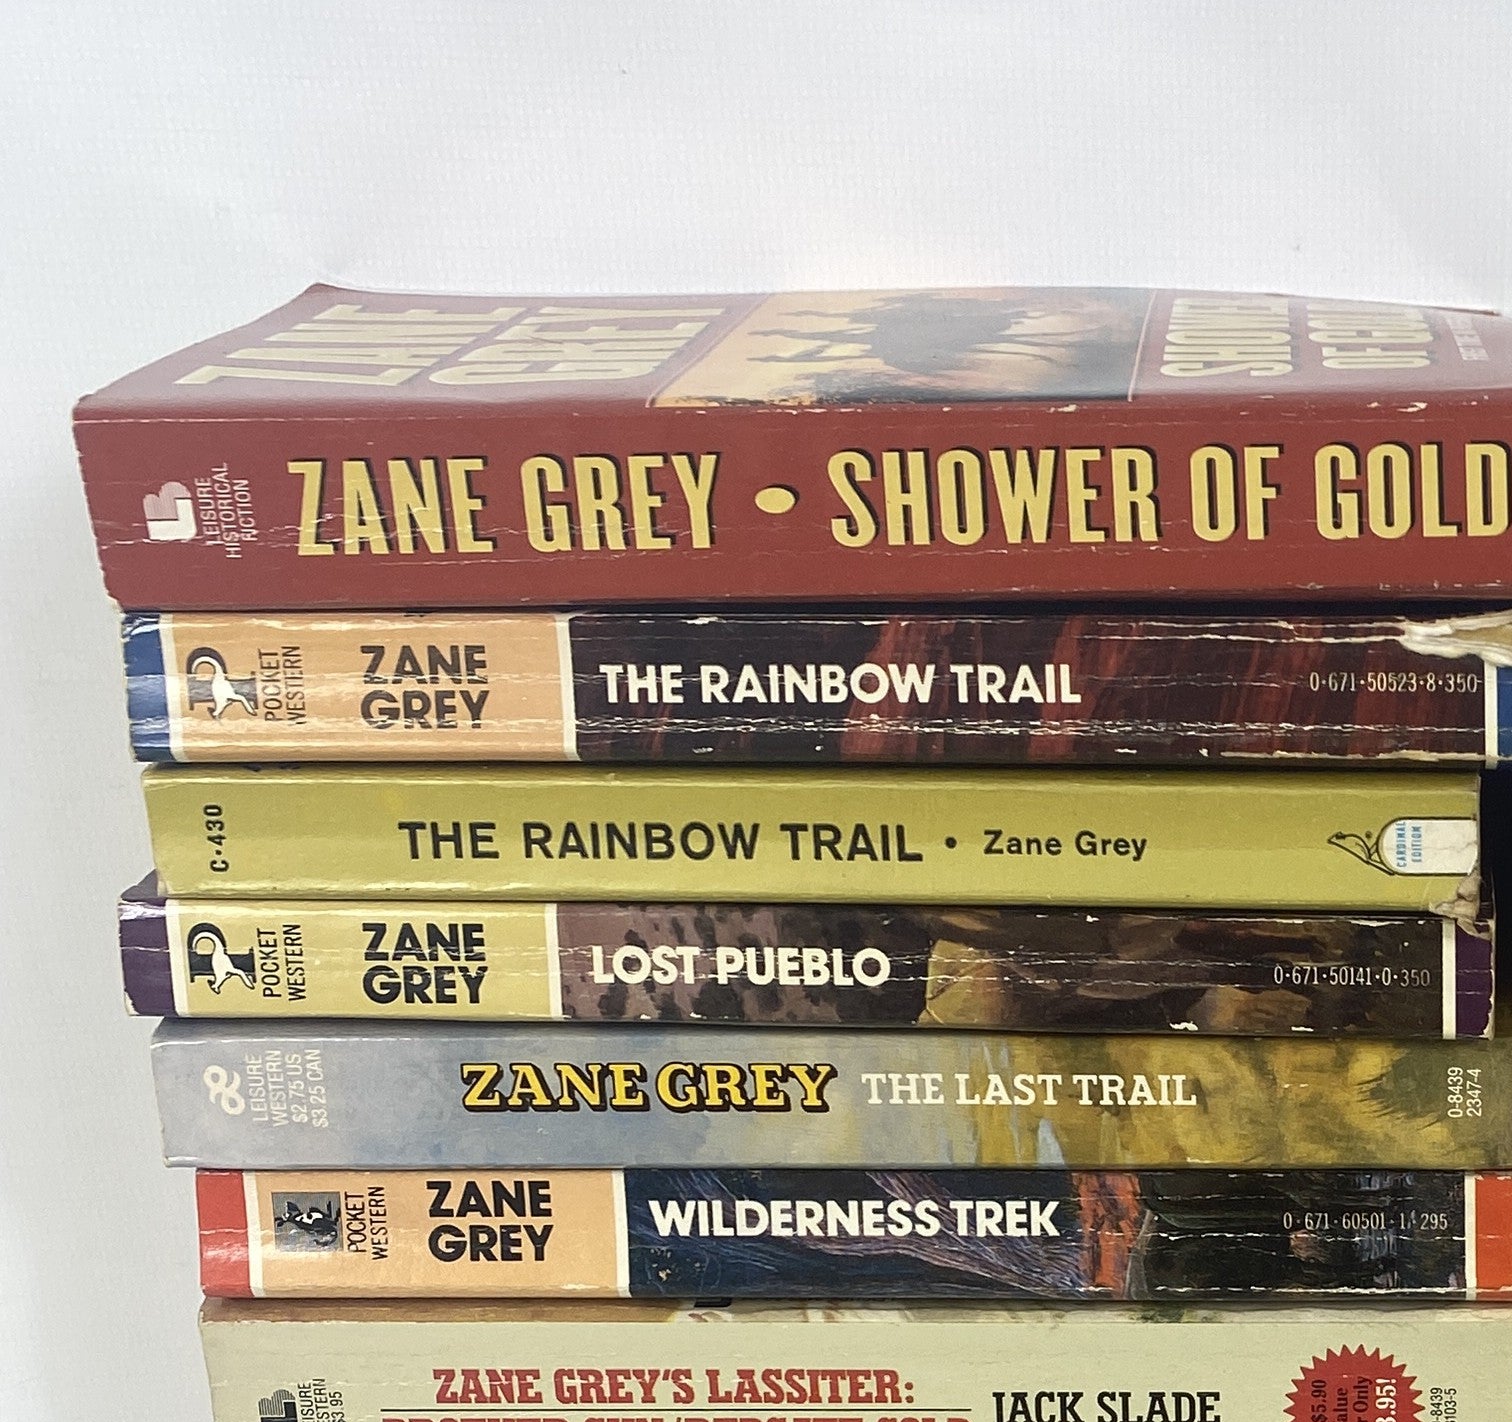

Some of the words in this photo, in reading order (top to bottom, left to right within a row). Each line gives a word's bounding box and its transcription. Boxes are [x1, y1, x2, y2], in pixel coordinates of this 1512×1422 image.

[195, 478, 225, 545] LEISURE
[211, 463, 242, 558] HISTORICAL
[287, 458, 494, 557] ZANE
[521, 452, 719, 552] GREY
[826, 446, 1161, 548] SHOWER
[1189, 444, 1282, 541] OF
[1314, 441, 1512, 539] GOLD
[398, 822, 499, 860] THE
[522, 823, 759, 861] RAINBOW
[780, 823, 923, 862] TRAIL
[982, 831, 1062, 857] Zane
[1075, 831, 1147, 862] Grey
[257, 928, 282, 998] POCKET
[283, 924, 306, 1001] WESTERN
[592, 944, 699, 985] LOST
[713, 946, 891, 986] PUEBLO
[246, 1055, 269, 1121] LEISURE
[266, 1051, 290, 1127] WESTERN
[460, 1061, 646, 1114] ZANE
[653, 1061, 838, 1114] GREY
[862, 1073, 944, 1106] THE
[955, 1075, 1063, 1106] LAST
[1072, 1075, 1198, 1107] TRAIL
[1448, 1067, 1463, 1118] 0-8439
[1466, 1068, 1481, 1117] 2347-4
[345, 1192, 366, 1253] POCKET
[368, 1186, 388, 1260] WESTERN
[648, 1200, 941, 1237] WILDERNESS
[950, 1200, 1062, 1237] TREK
[433, 1368, 541, 1404] ZANE
[554, 1367, 695, 1404] GREY'S
[704, 1368, 914, 1404] LASSITER:
[1353, 1376, 1372, 1412] Only
